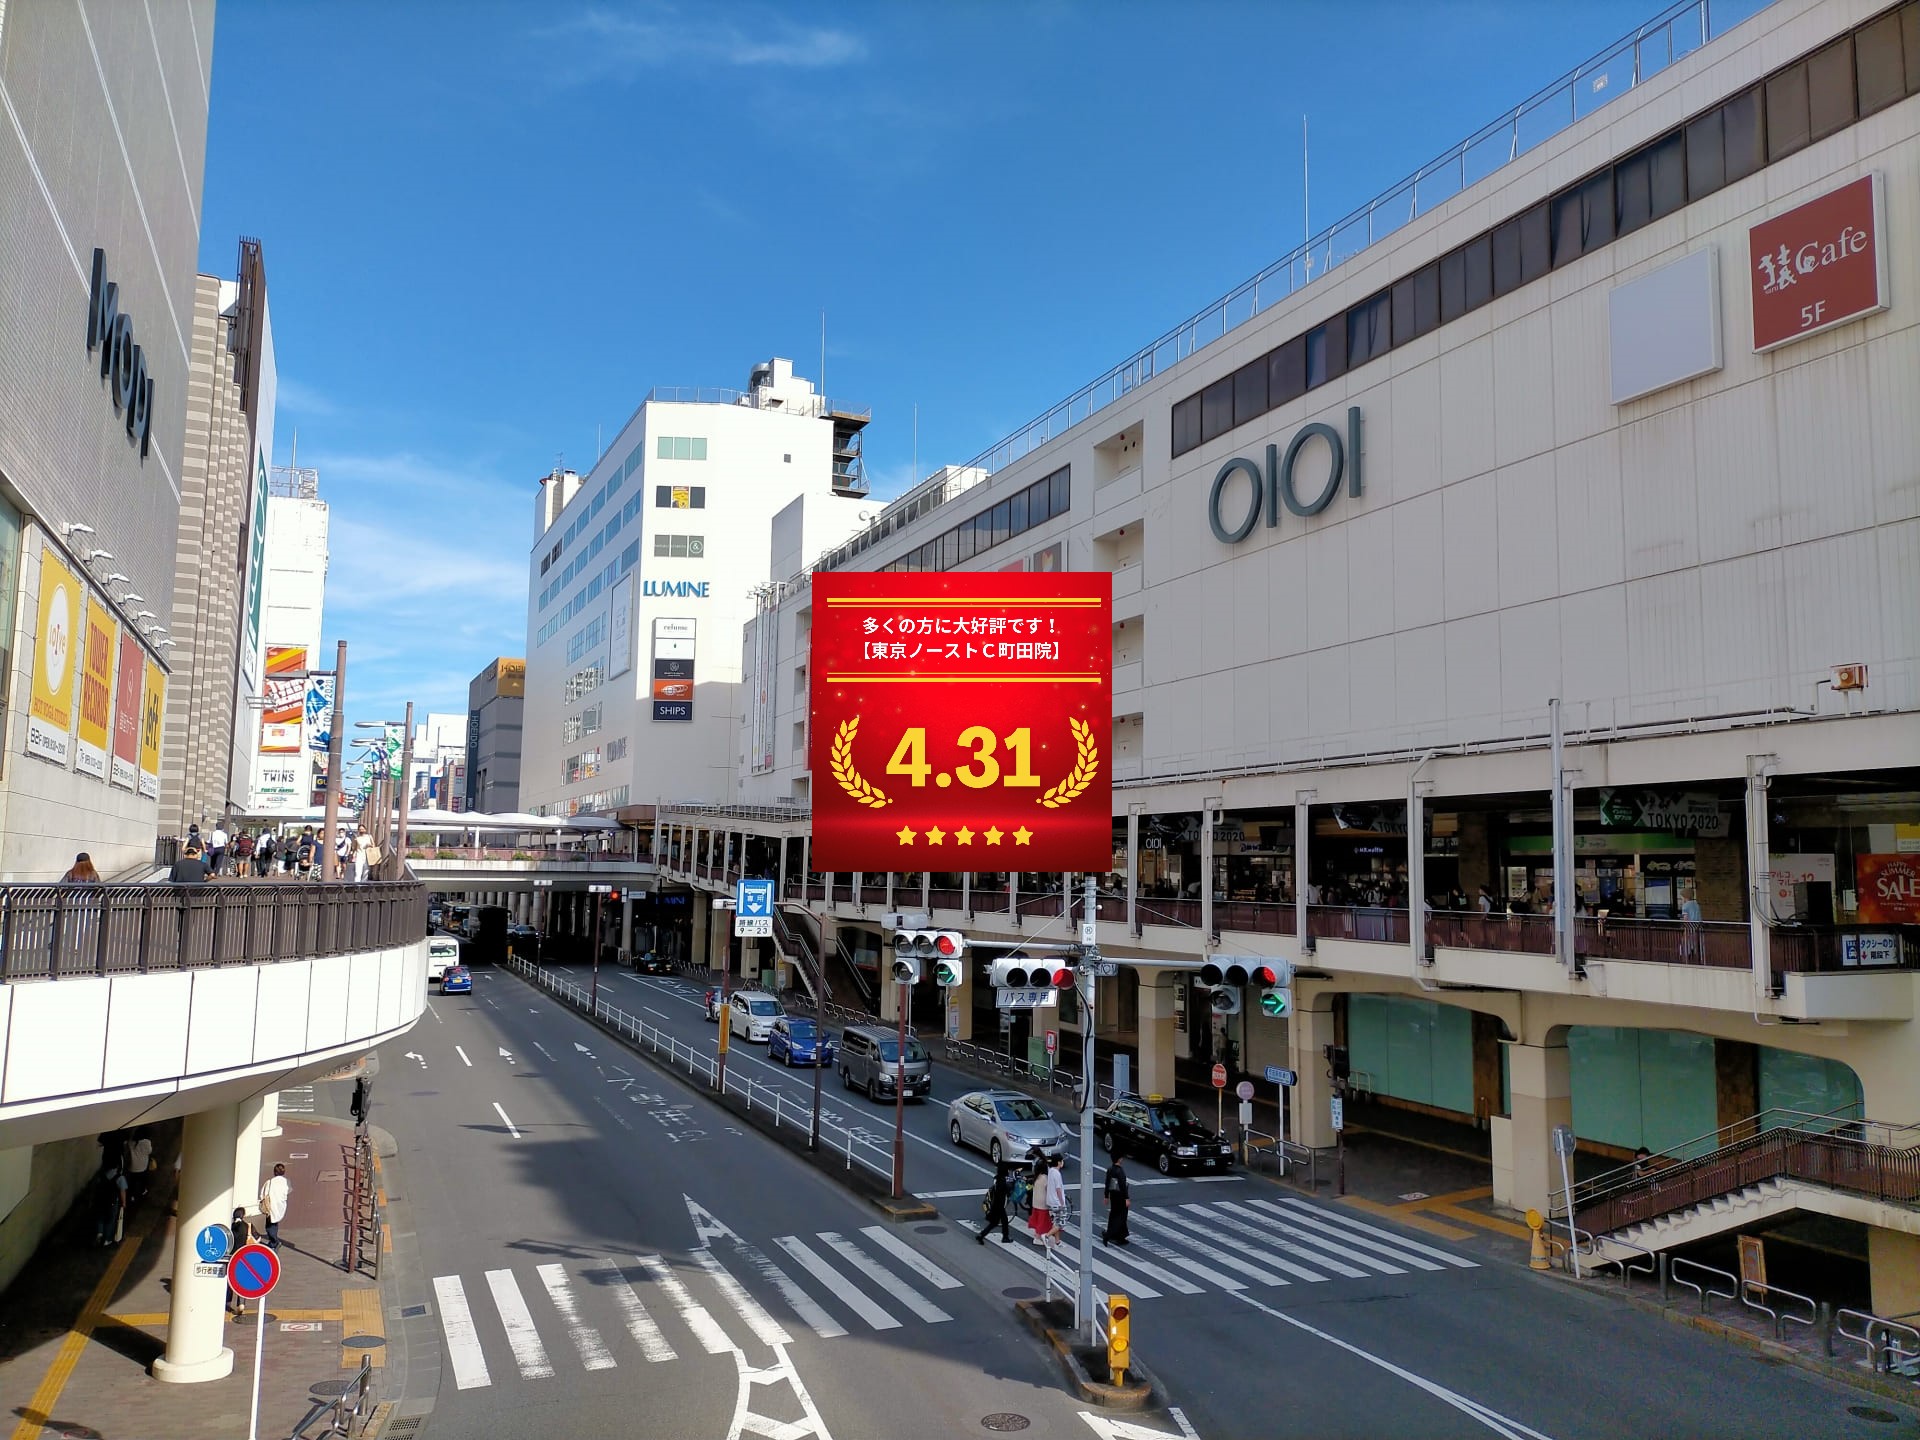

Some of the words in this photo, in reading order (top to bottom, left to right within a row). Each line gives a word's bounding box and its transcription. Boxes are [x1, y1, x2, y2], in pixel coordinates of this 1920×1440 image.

[1801, 300, 1826, 327] 5F
[86, 247, 155, 457] MODI
[643, 580, 710, 598] LUMINE
[90, 622, 109, 681] TOWER
[325, 680, 334, 698] 2020
[83, 672, 109, 731] RECORDS
[660, 706, 686, 716] SHIPS
[263, 773, 294, 783] TWINS
[1647, 812, 1688, 828] TOKYO
[1690, 814, 1719, 830] 2020
[1187, 830, 1220, 841] TOO
[1221, 831, 1245, 842] 2020
[1880, 866, 1916, 879] SUMMER
[1876, 875, 1920, 901] SALE
[1860, 938, 1897, 949] タクシーのり
[1870, 950, 1890, 960] 階段下
[1004, 991, 1050, 1003] バス専用
